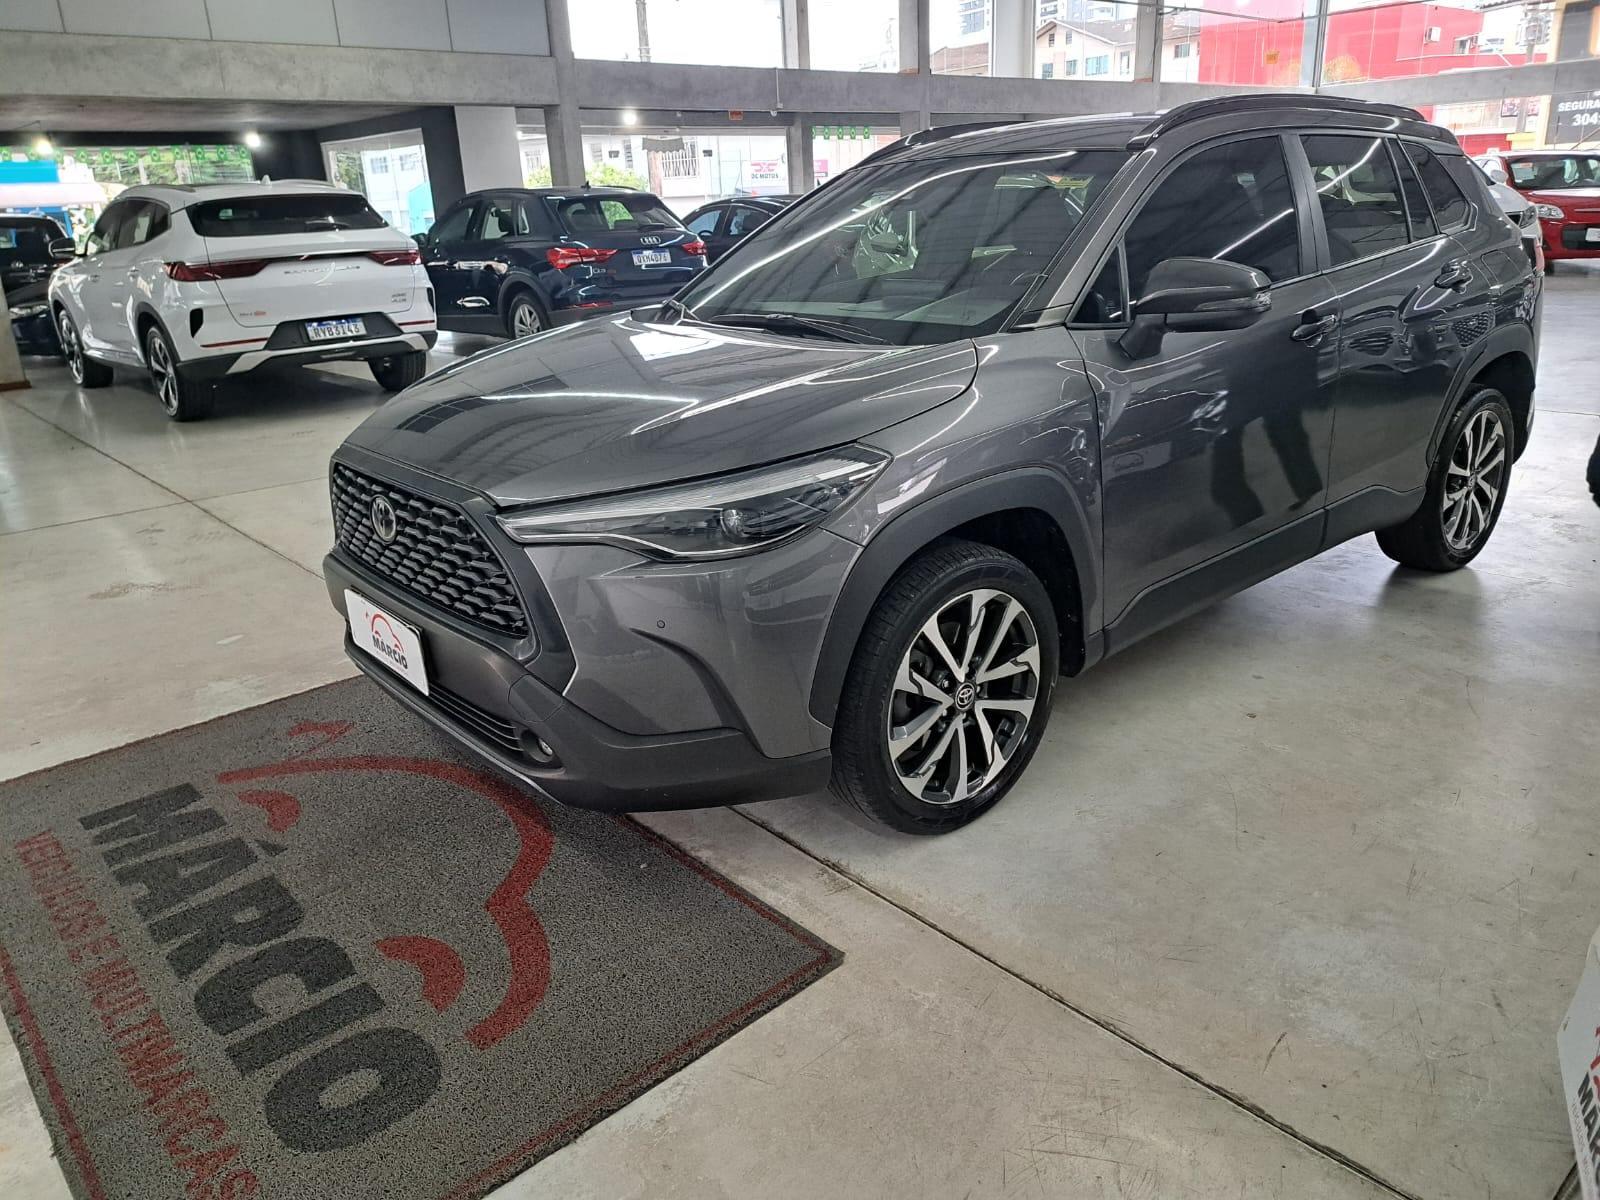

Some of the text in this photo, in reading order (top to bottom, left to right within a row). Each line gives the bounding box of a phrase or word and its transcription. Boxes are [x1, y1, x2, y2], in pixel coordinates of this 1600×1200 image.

[1571, 112, 1600, 126] 304
[68, 934, 121, 964] E
[78, 782, 442, 1154] MÁRCIO
